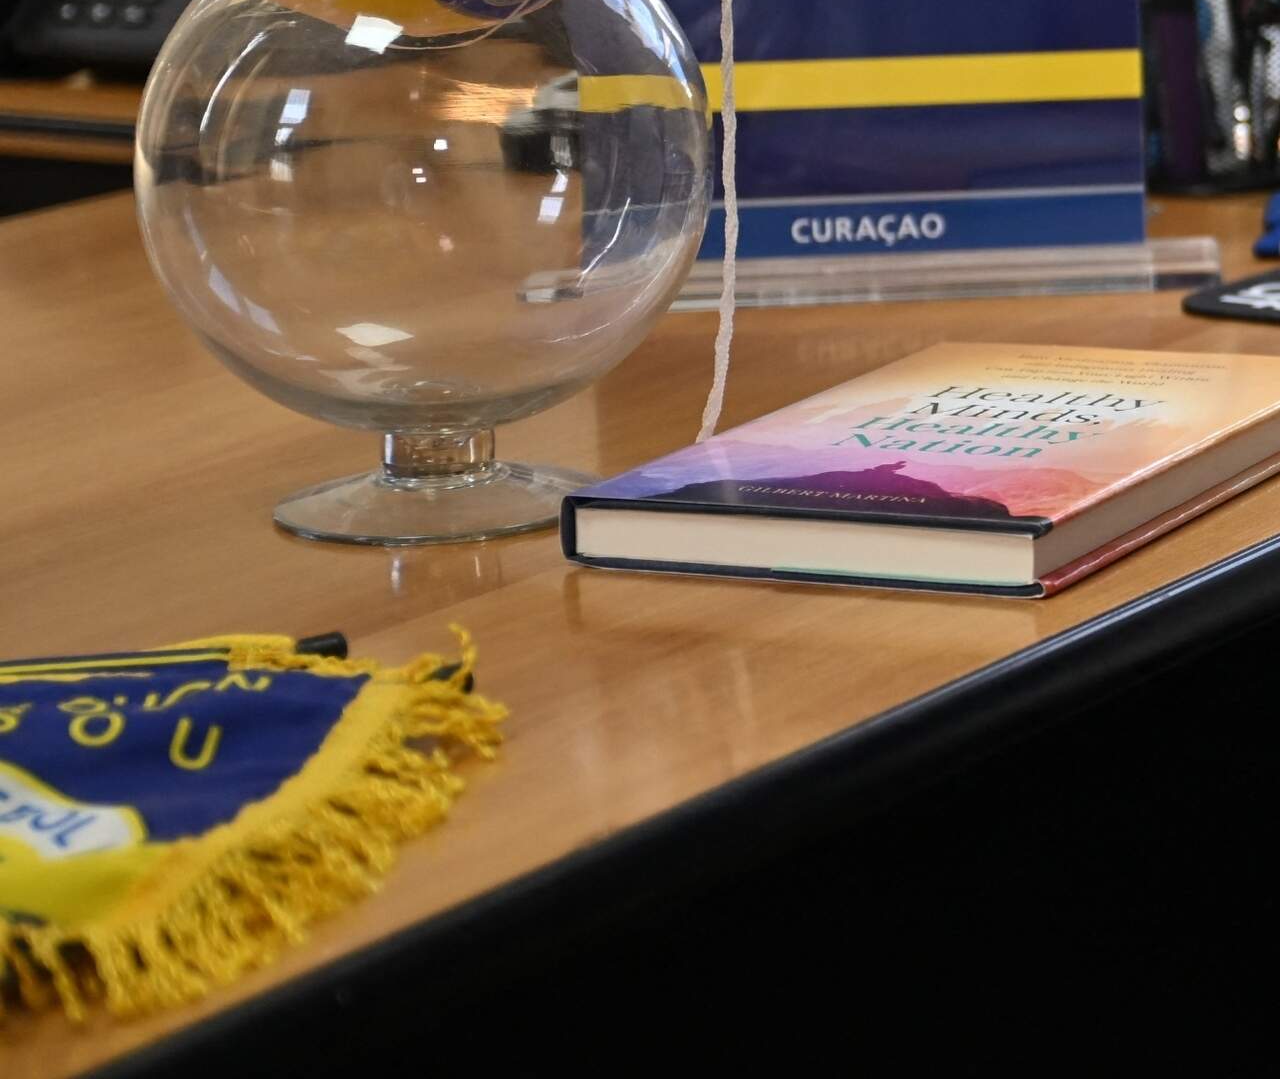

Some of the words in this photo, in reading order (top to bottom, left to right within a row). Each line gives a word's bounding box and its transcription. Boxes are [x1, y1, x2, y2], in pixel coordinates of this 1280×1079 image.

[791, 213, 945, 246] CURAÇAO
[927, 385, 1167, 412] Healthy
[850, 416, 1106, 445] Healthy
[831, 432, 1044, 459] Nation
[738, 485, 828, 498] GILBERT
[829, 491, 926, 505] MARTINA
